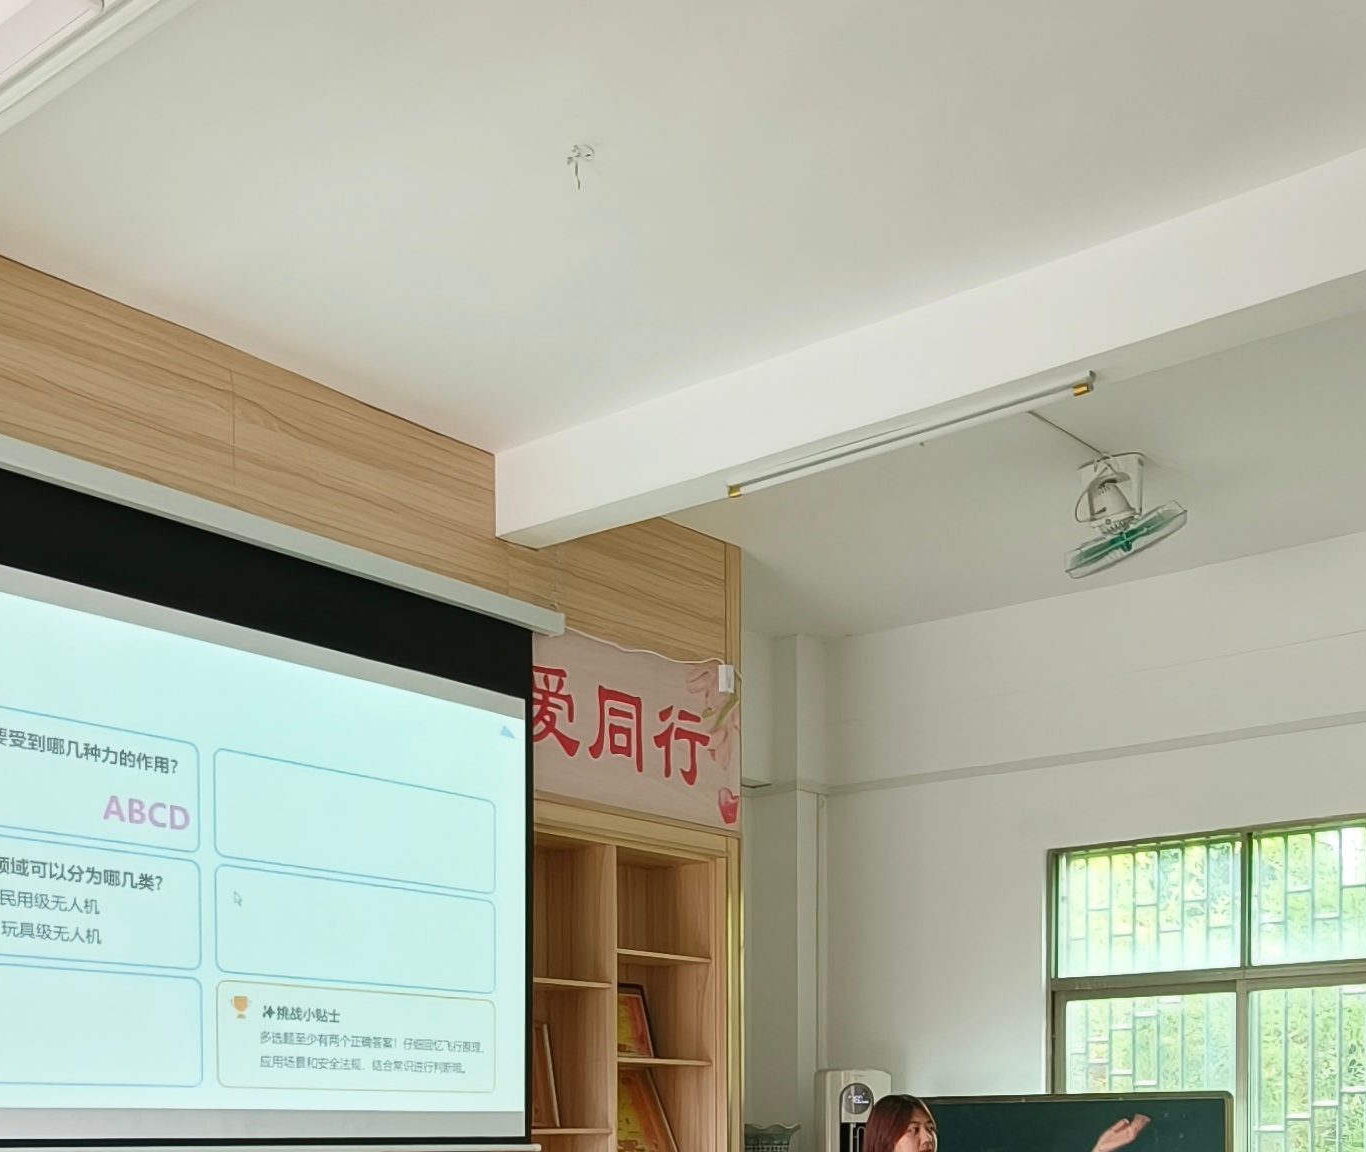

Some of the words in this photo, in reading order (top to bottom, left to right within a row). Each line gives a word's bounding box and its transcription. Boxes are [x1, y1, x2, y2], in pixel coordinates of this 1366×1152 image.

[532, 664, 710, 786] 爱同行
[102, 794, 191, 831] ABCD
[0, 889, 101, 916] 民用级无人机
[0, 921, 102, 945] 玩具级无人机
[276, 1005, 341, 1024] 挑战小贴士
